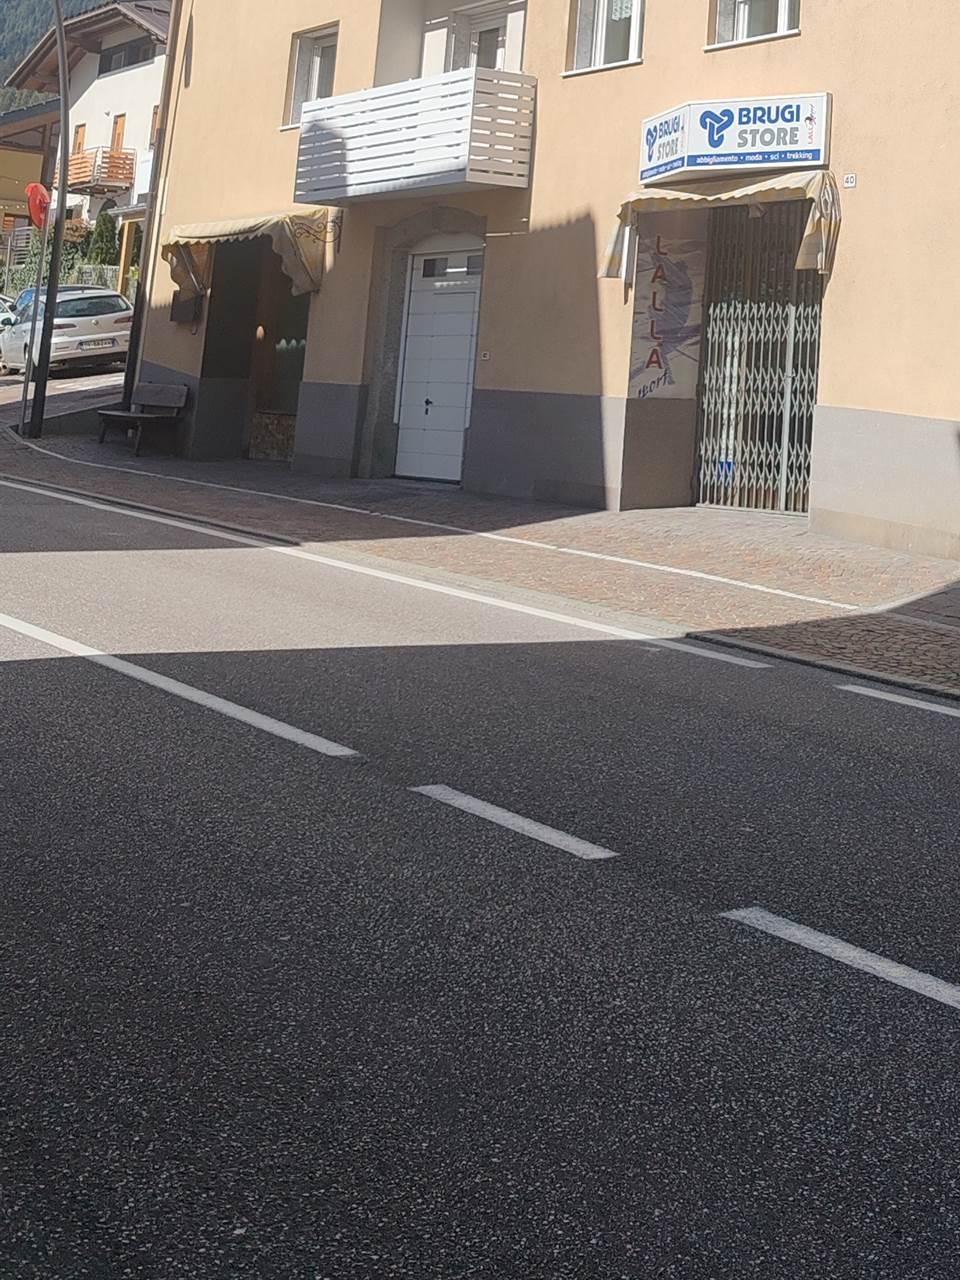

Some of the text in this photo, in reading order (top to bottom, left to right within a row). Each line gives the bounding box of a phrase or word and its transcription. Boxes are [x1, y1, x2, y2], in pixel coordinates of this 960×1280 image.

[737, 104, 802, 126] BRUGI
[658, 114, 681, 139] BRUGI
[737, 126, 800, 148] STORE
[656, 136, 679, 161] STORE
[696, 151, 813, 165] abbigliamento moda sci trekking
[844, 175, 855, 185] 40
[645, 234, 668, 370] LALLA
